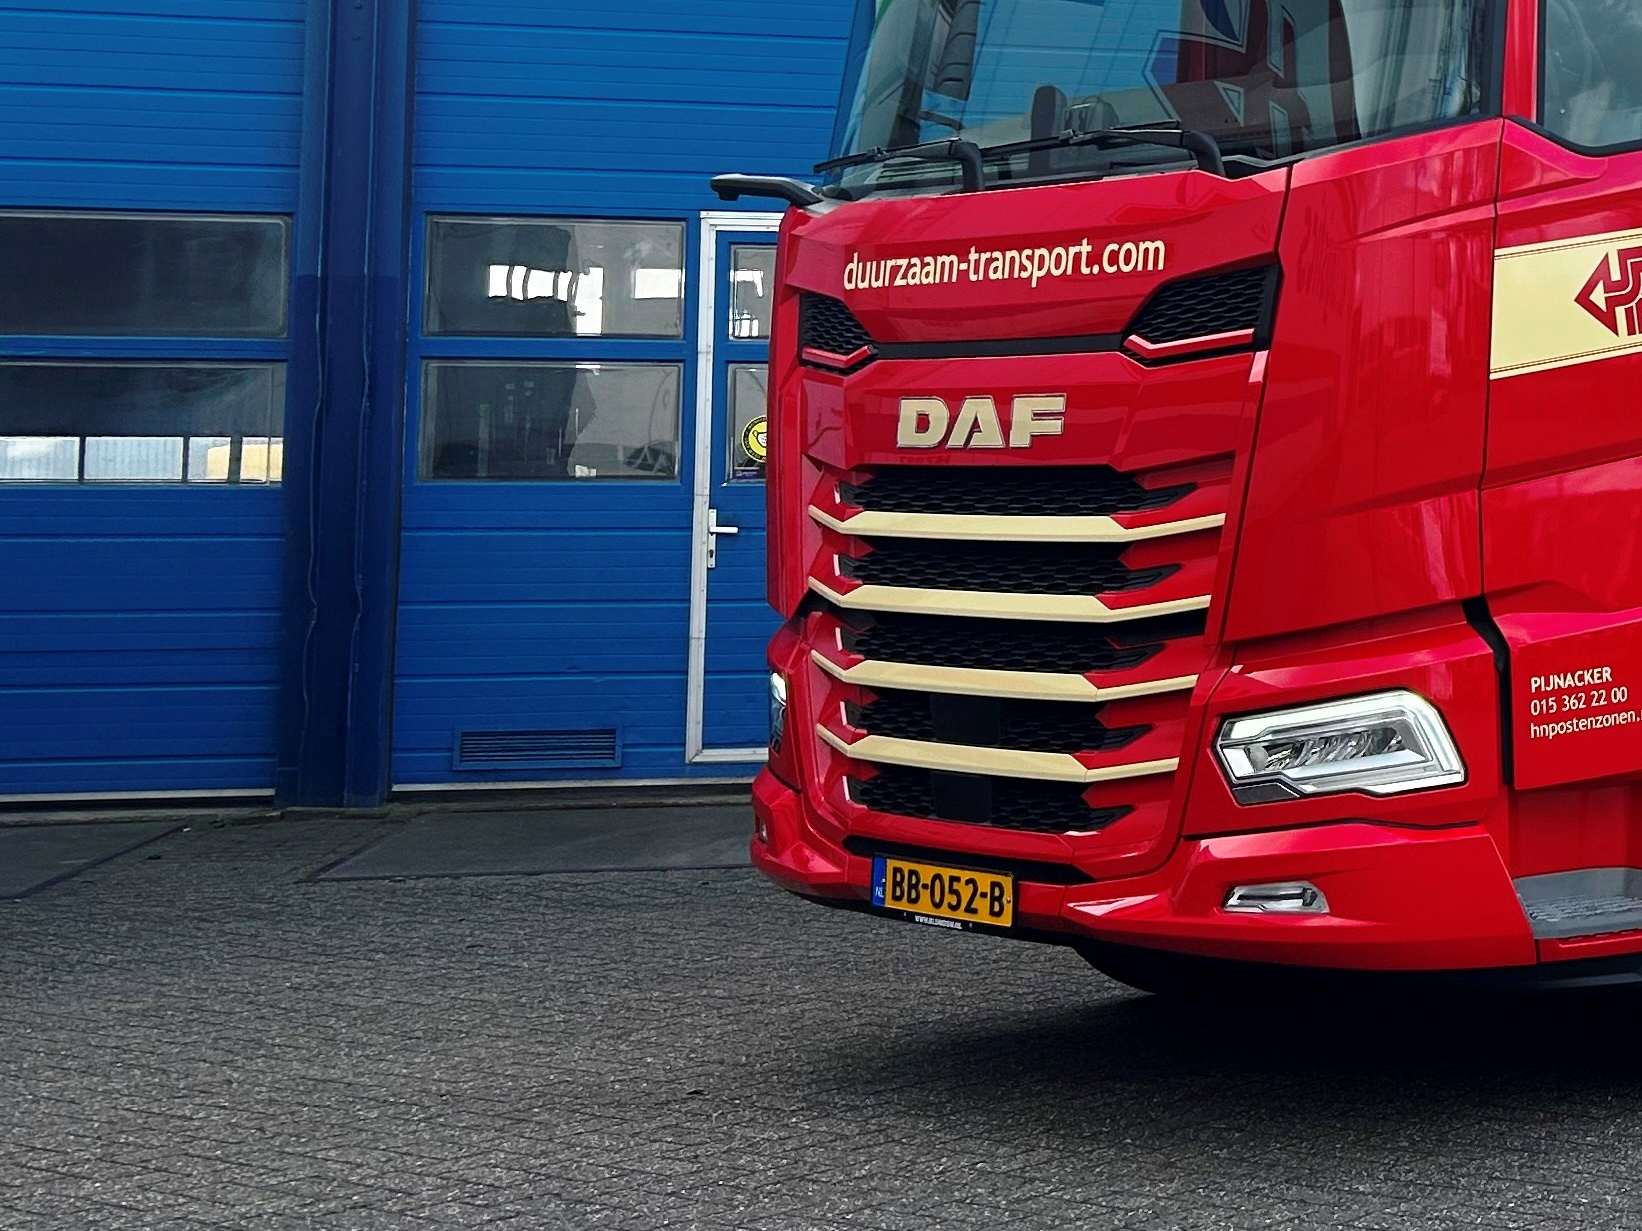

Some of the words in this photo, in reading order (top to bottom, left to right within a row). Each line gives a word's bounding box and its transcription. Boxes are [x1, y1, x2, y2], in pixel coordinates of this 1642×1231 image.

[843, 238, 1165, 290] duurzaam-transport.com
[897, 393, 1067, 449] DAF
[1530, 666, 1612, 693] PIJNACKER
[1530, 697, 1557, 716] 015
[1561, 692, 1586, 711] 362
[1590, 689, 1607, 707] 22
[1611, 686, 1628, 703] 00
[891, 866, 1005, 917] BB-052-B
